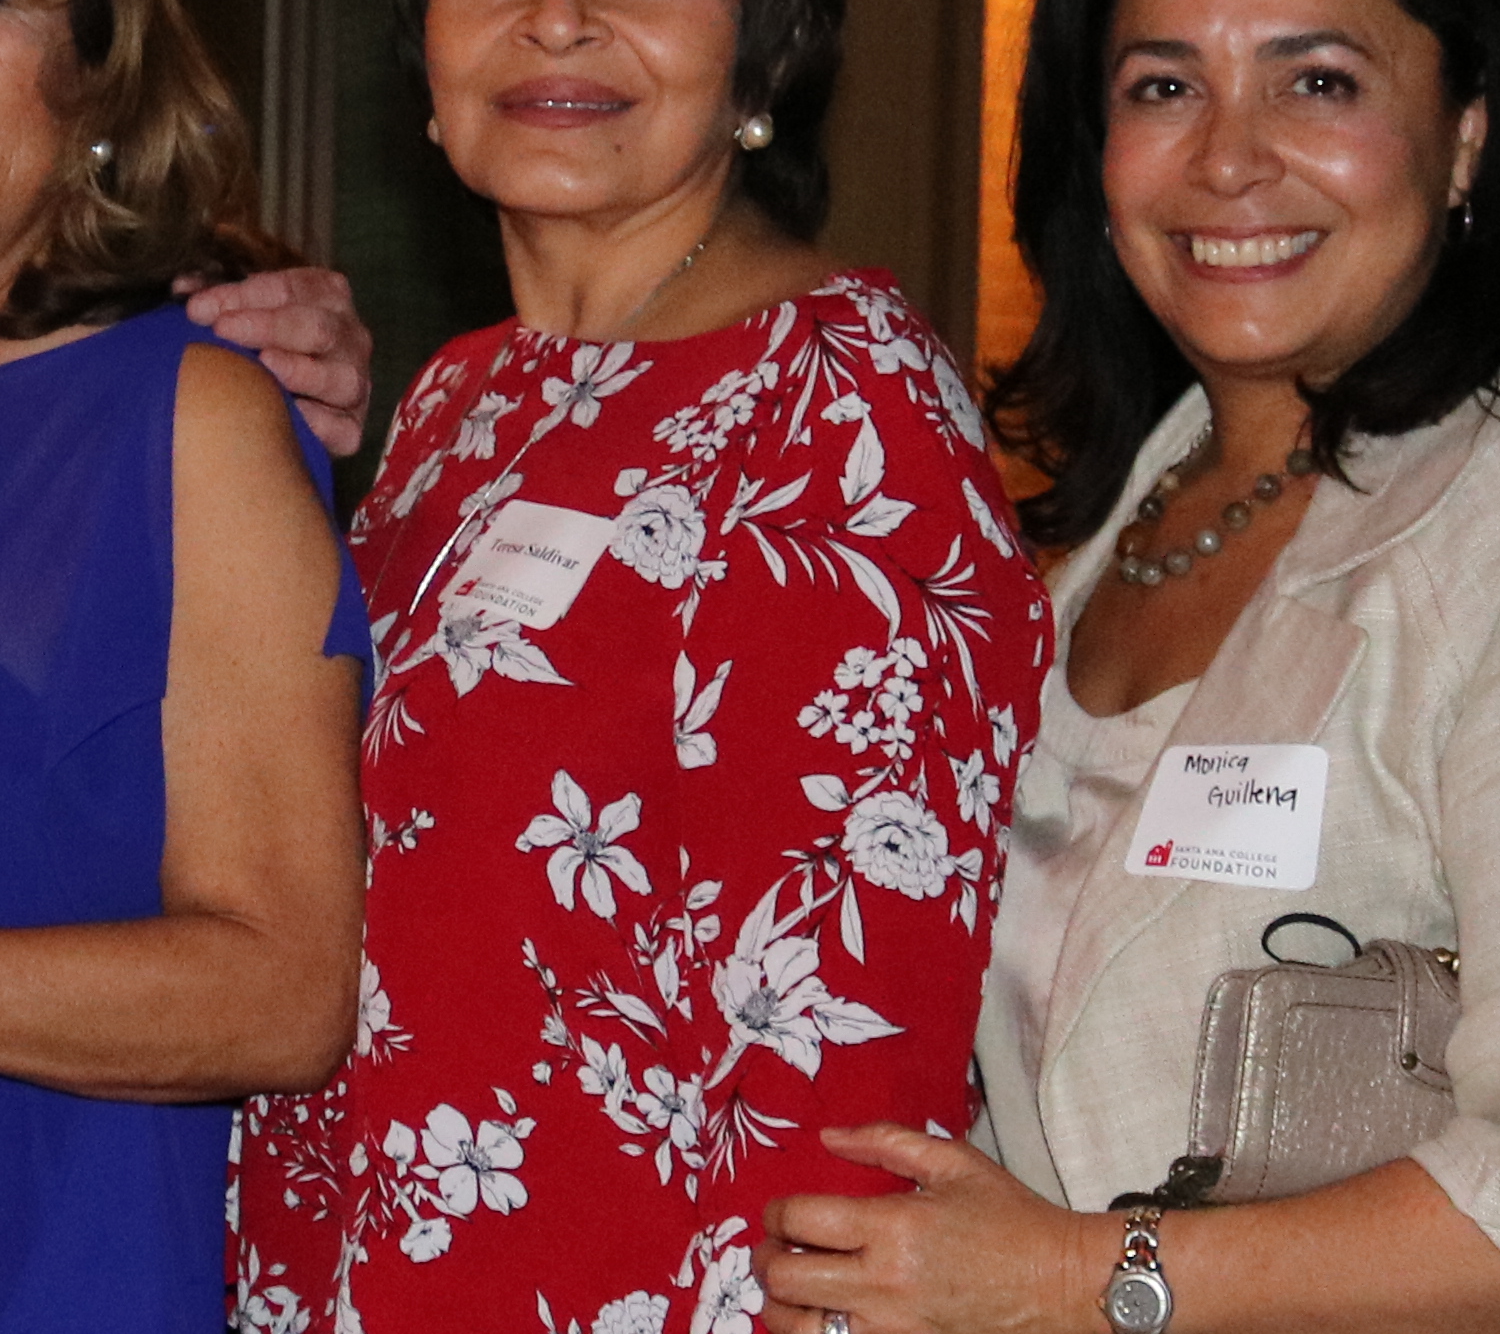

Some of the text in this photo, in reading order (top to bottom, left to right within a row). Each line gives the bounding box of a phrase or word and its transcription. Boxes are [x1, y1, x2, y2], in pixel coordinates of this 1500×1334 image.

[1184, 751, 1250, 775] Monica
[1205, 847, 1225, 858] ANA
[1229, 850, 1278, 864] COLLEGE
[1170, 856, 1278, 879] FOUNDATION
